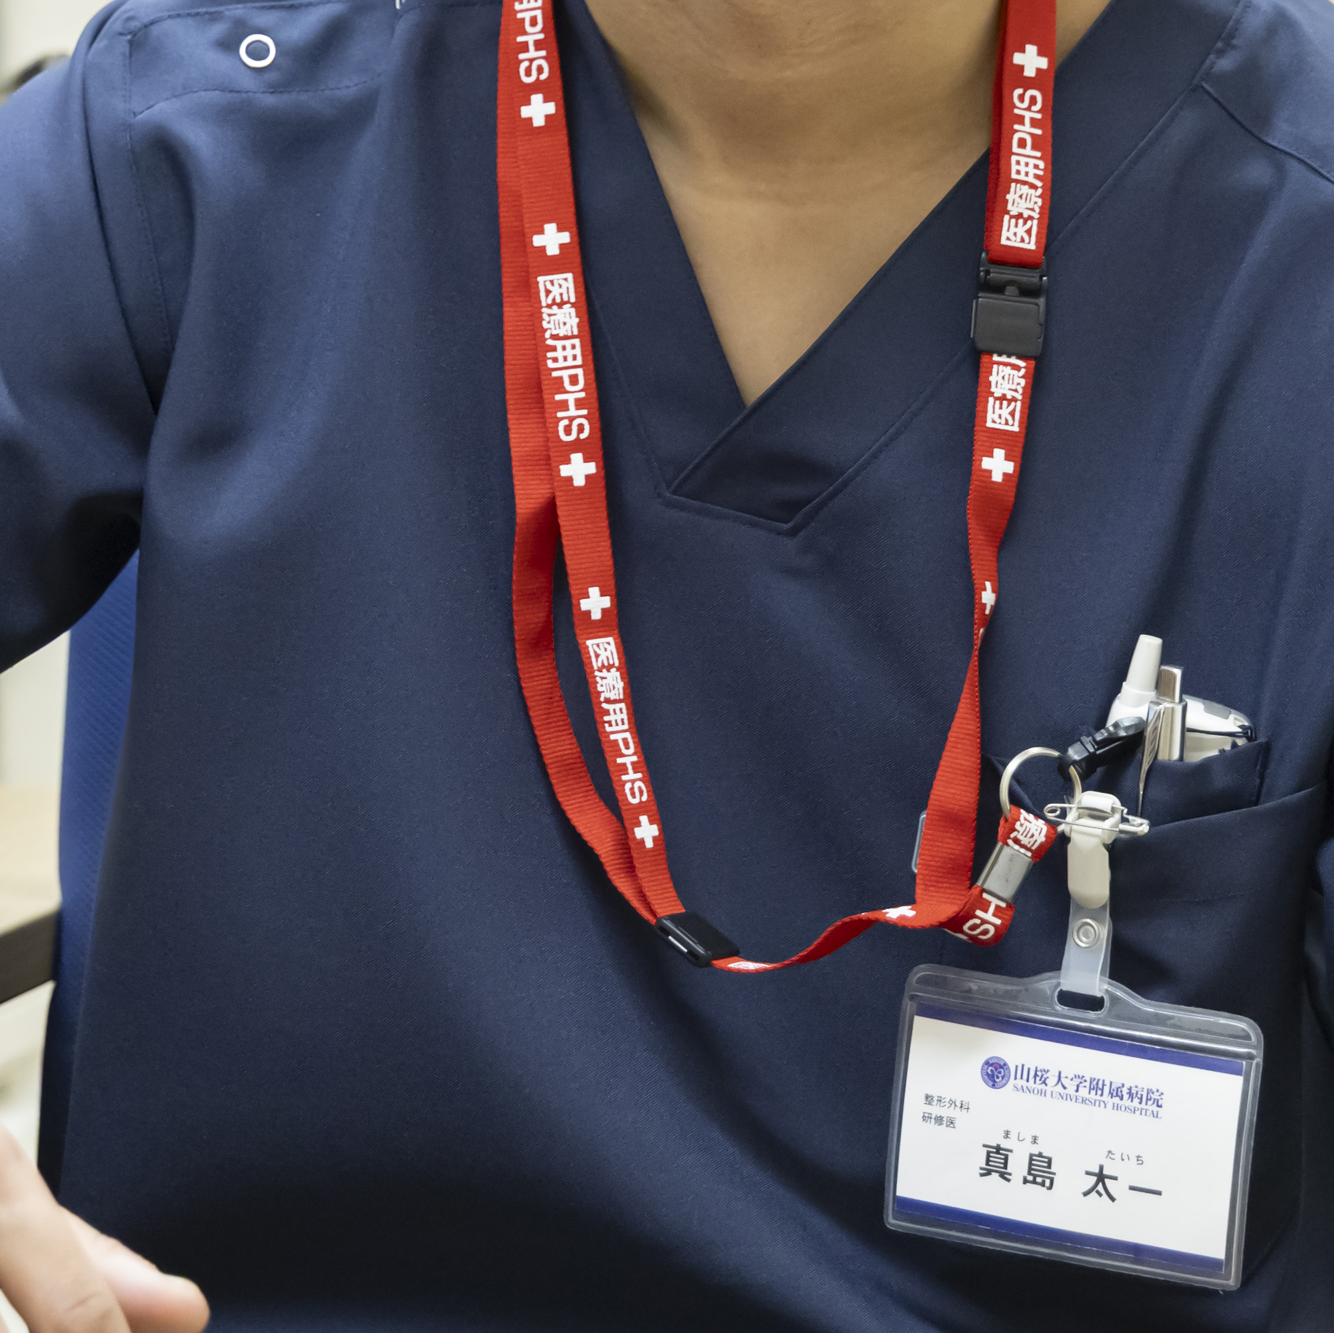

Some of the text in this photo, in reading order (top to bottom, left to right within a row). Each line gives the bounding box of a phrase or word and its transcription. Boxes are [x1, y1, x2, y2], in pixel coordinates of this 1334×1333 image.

[1000, 88, 1045, 250] 医療用PHS
[536, 272, 590, 442] 医療用PHS
[985, 353, 1027, 432] 医療
[585, 636, 648, 805] 医療用PHS
[923, 1093, 970, 1113] 整形外科
[1012, 1083, 1163, 1120] SANOH UNIVERSITY HOSPITAL
[1013, 1063, 1164, 1109] 山桜大学附属病院
[921, 1111, 957, 1129] 研修医
[1002, 1129, 1040, 1146] ましま
[978, 1142, 1163, 1204] 真島 太一
[1105, 1149, 1144, 1166] たいち
